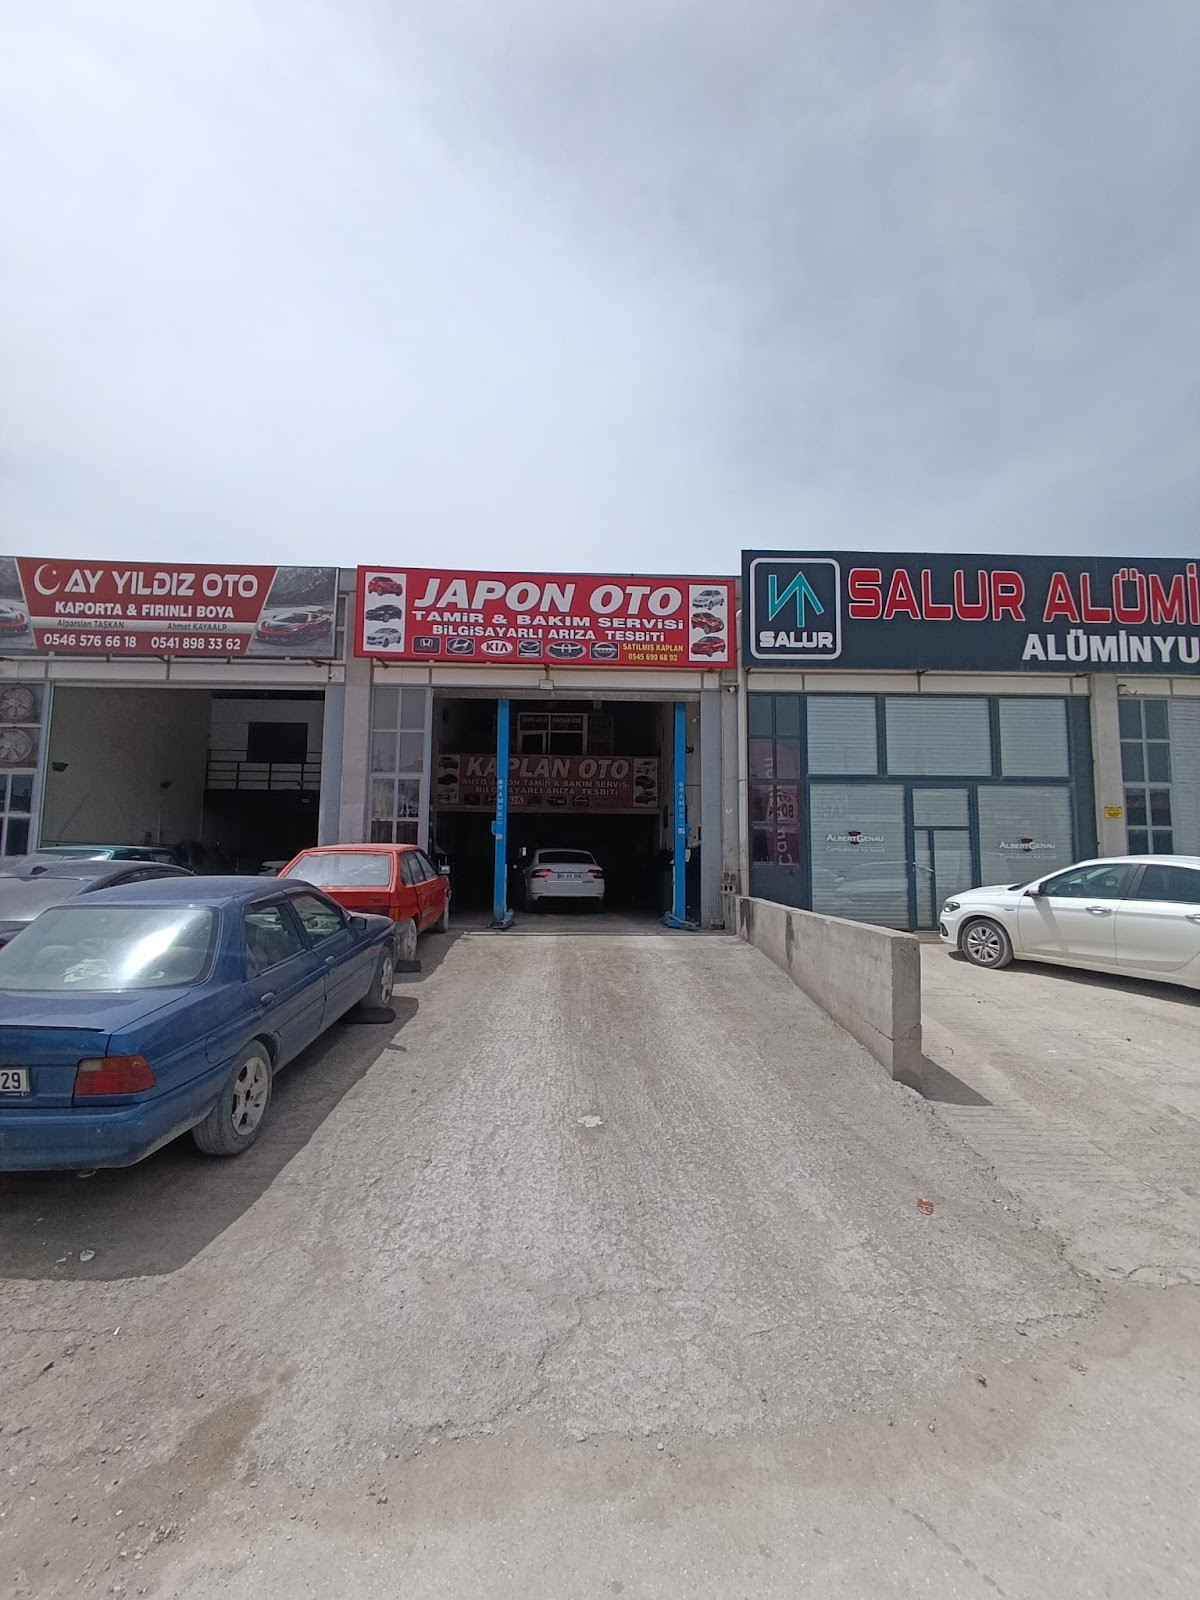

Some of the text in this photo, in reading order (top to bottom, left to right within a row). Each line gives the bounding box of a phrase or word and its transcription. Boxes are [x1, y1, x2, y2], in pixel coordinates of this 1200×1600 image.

[64, 568, 258, 598] AY YILDIZ OTO
[413, 577, 682, 616] JAPON OTO
[847, 562, 1200, 625] SALUR ALÜMİ
[55, 601, 234, 619] KAPORTA & FIRINLI BOYA
[166, 622, 227, 631] Ahmet KAYAALP
[491, 614, 508, 625] &
[517, 614, 590, 627] BAKIM
[43, 633, 137, 648] 0546 576 66 18
[547, 629, 596, 640] ARIZA
[758, 630, 834, 649] SALUR
[150, 636, 241, 650] 0541 898 33 62
[656, 644, 684, 652] KAPLAN
[1022, 629, 1200, 664] ALÜMİNYU
[628, 653, 645, 661] 0545
[578, 758, 630, 779] OTO
[547, 787, 576, 796] ARIZA
[563, 780, 593, 789] BAKIM
[1, 1072, 21, 1090] 29
